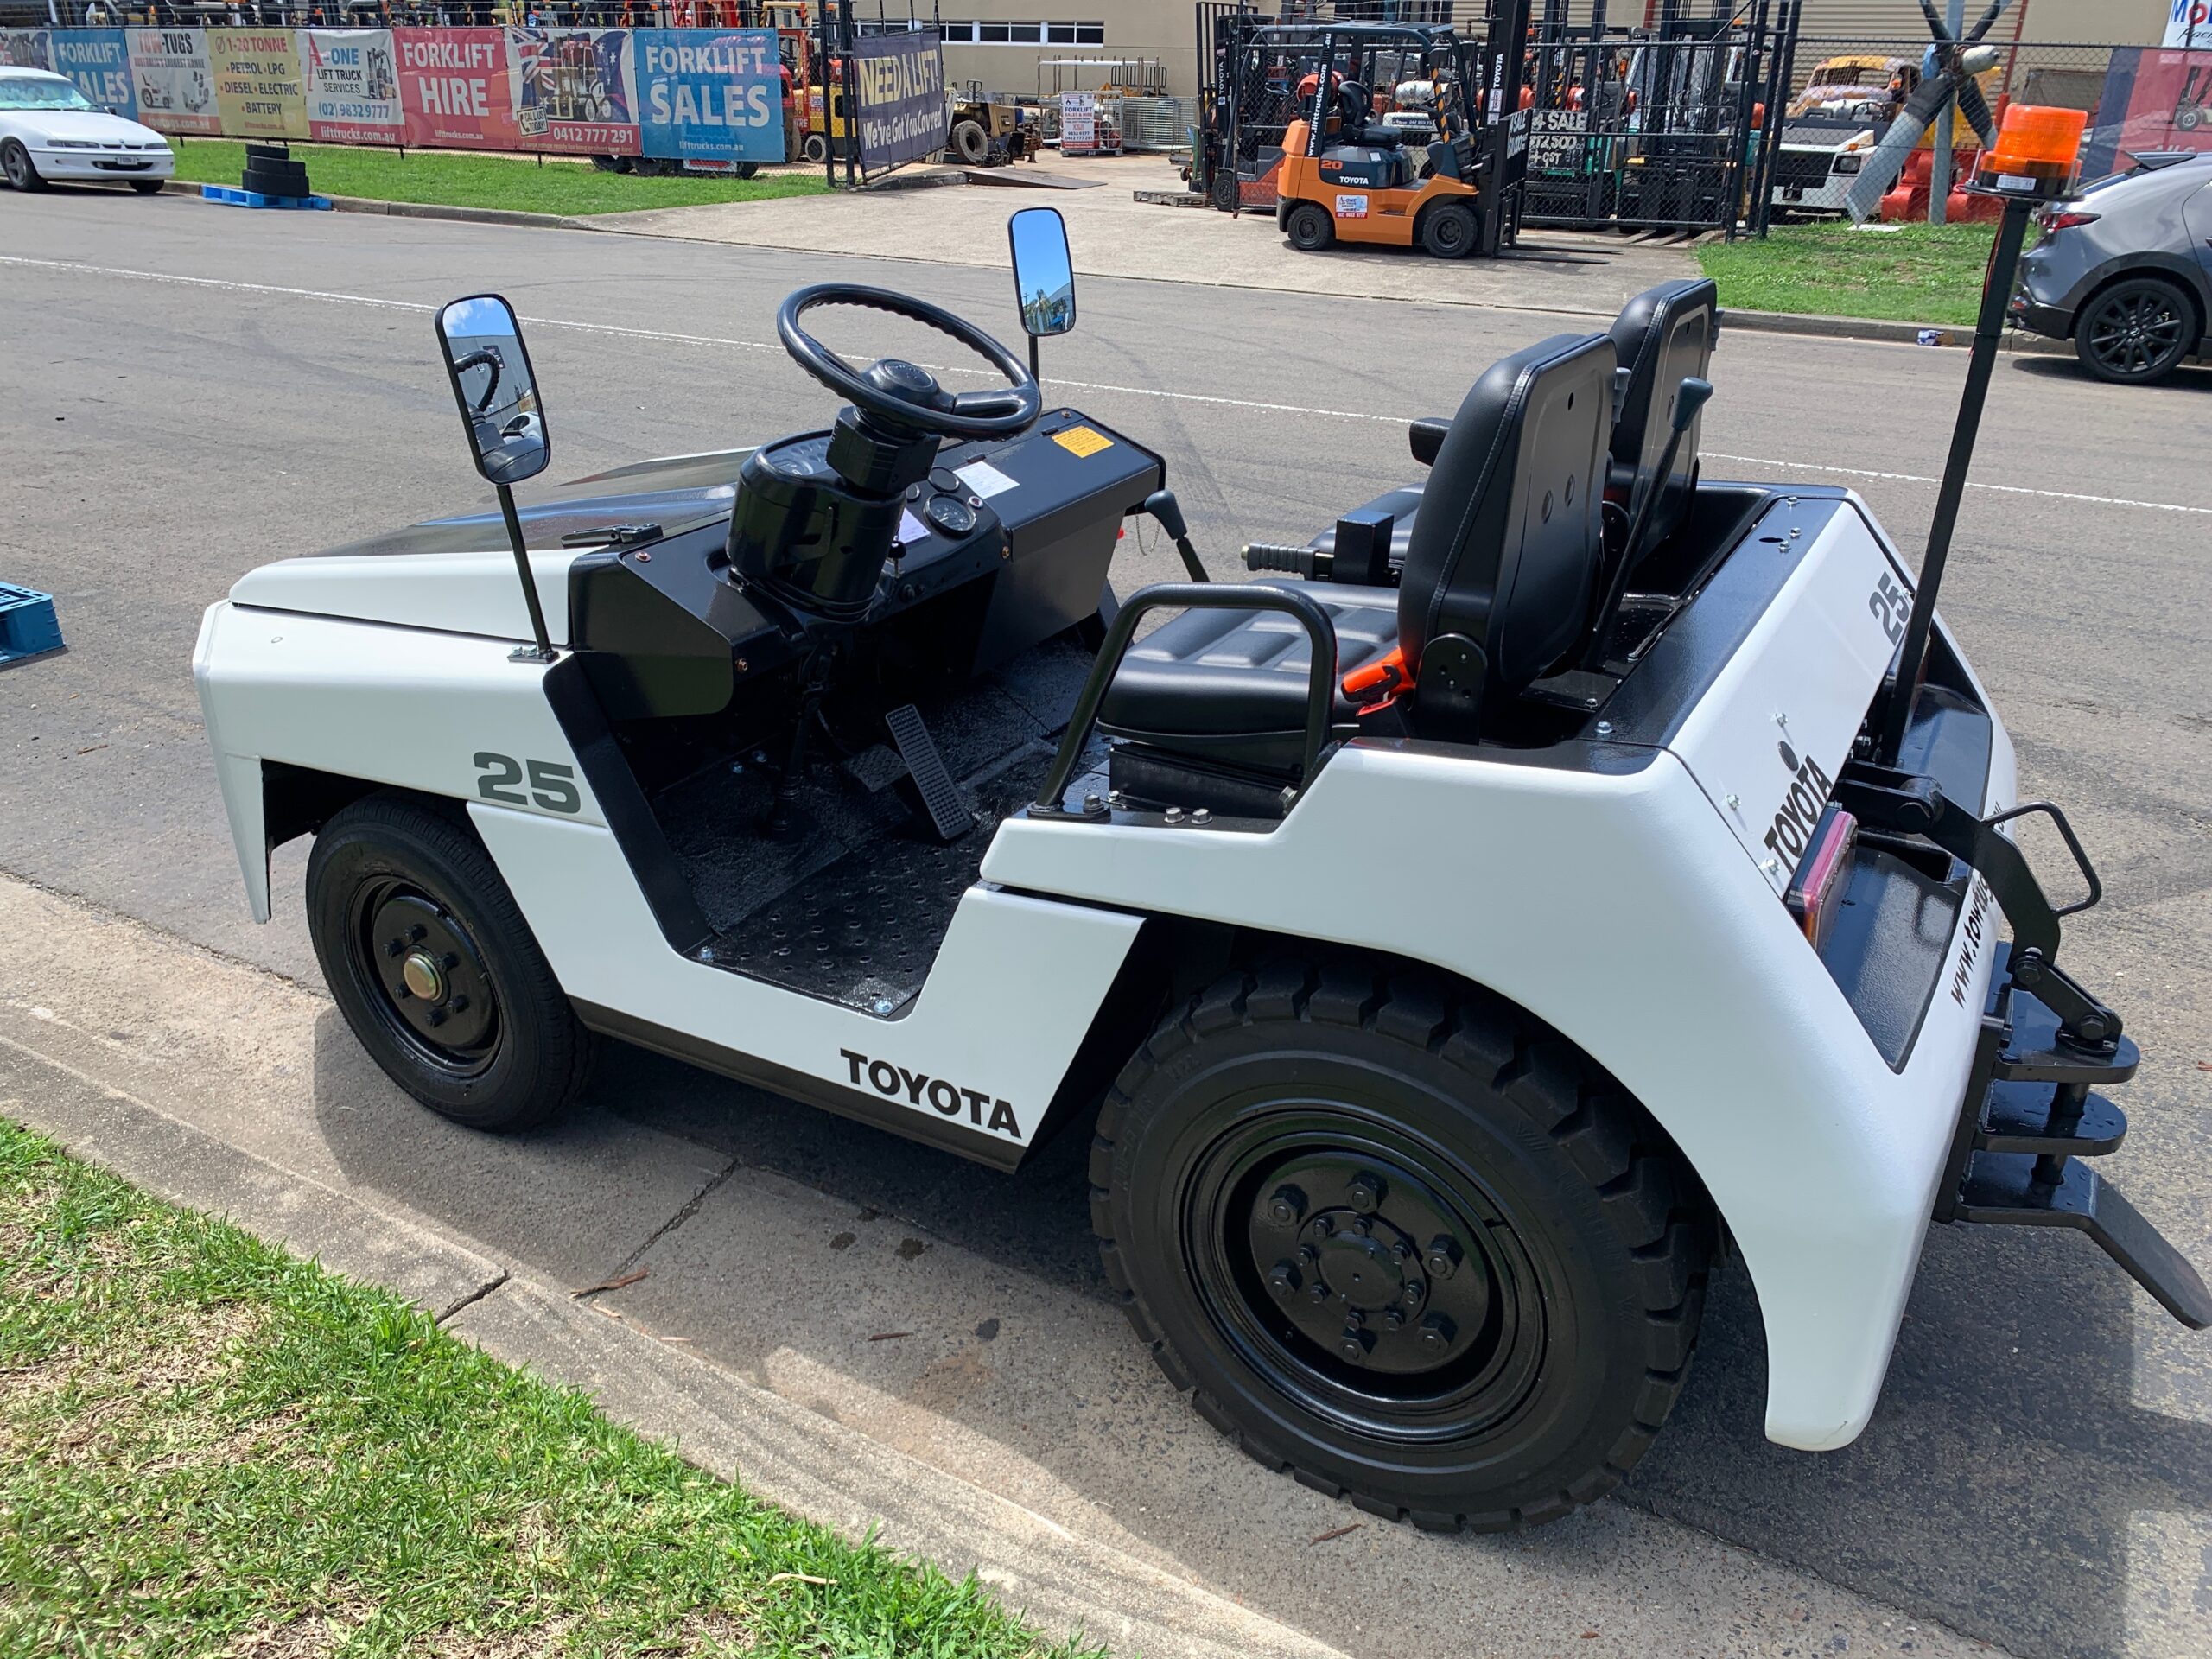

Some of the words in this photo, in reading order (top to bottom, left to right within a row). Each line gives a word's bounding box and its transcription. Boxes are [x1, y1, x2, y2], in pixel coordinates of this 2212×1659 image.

[60, 42, 121, 63] FORKLIFT
[137, 32, 193, 54] TOW-TUGS
[226, 39, 250, 52] 1-20
[251, 37, 288, 53] TONNE
[403, 42, 494, 68] FORKLIFT
[645, 46, 766, 74] FORKLIFT
[230, 62, 263, 74] PETROL
[266, 63, 285, 75] LPG
[316, 69, 334, 80] LIFT
[335, 70, 362, 81] TRUCK
[1493, 53, 1503, 88] TOYOTA
[225, 82, 253, 93] DIESEL
[259, 83, 298, 96] ELECTRIC
[324, 82, 361, 94] SERVICES
[858, 55, 902, 107] NEED
[901, 54, 912, 99] A
[418, 76, 490, 117] HIRE
[650, 84, 770, 127] SALES
[245, 102, 282, 115] BATTERY
[318, 102, 338, 118] (02)
[340, 104, 363, 117] 9832
[365, 105, 389, 118] 9777
[524, 111, 537, 122] CALL
[537, 110, 544, 120] US
[863, 119, 891, 149] We've
[892, 116, 904, 143] Got
[904, 112, 917, 138] You
[1548, 111, 1587, 131] SALE
[321, 125, 395, 142] lifttrucks.com.au
[553, 126, 583, 142] 0412
[584, 128, 607, 143] 777
[611, 130, 633, 143] 291
[679, 140, 744, 151] lifttrucks.com.au
[1321, 160, 1343, 170] 20
[1339, 175, 1369, 185] TOYOTA
[1869, 570, 1910, 646] 25
[474, 752, 581, 814] 25
[1764, 754, 1834, 876] TOYOTA
[840, 1048, 1022, 1139] TOYOTA
